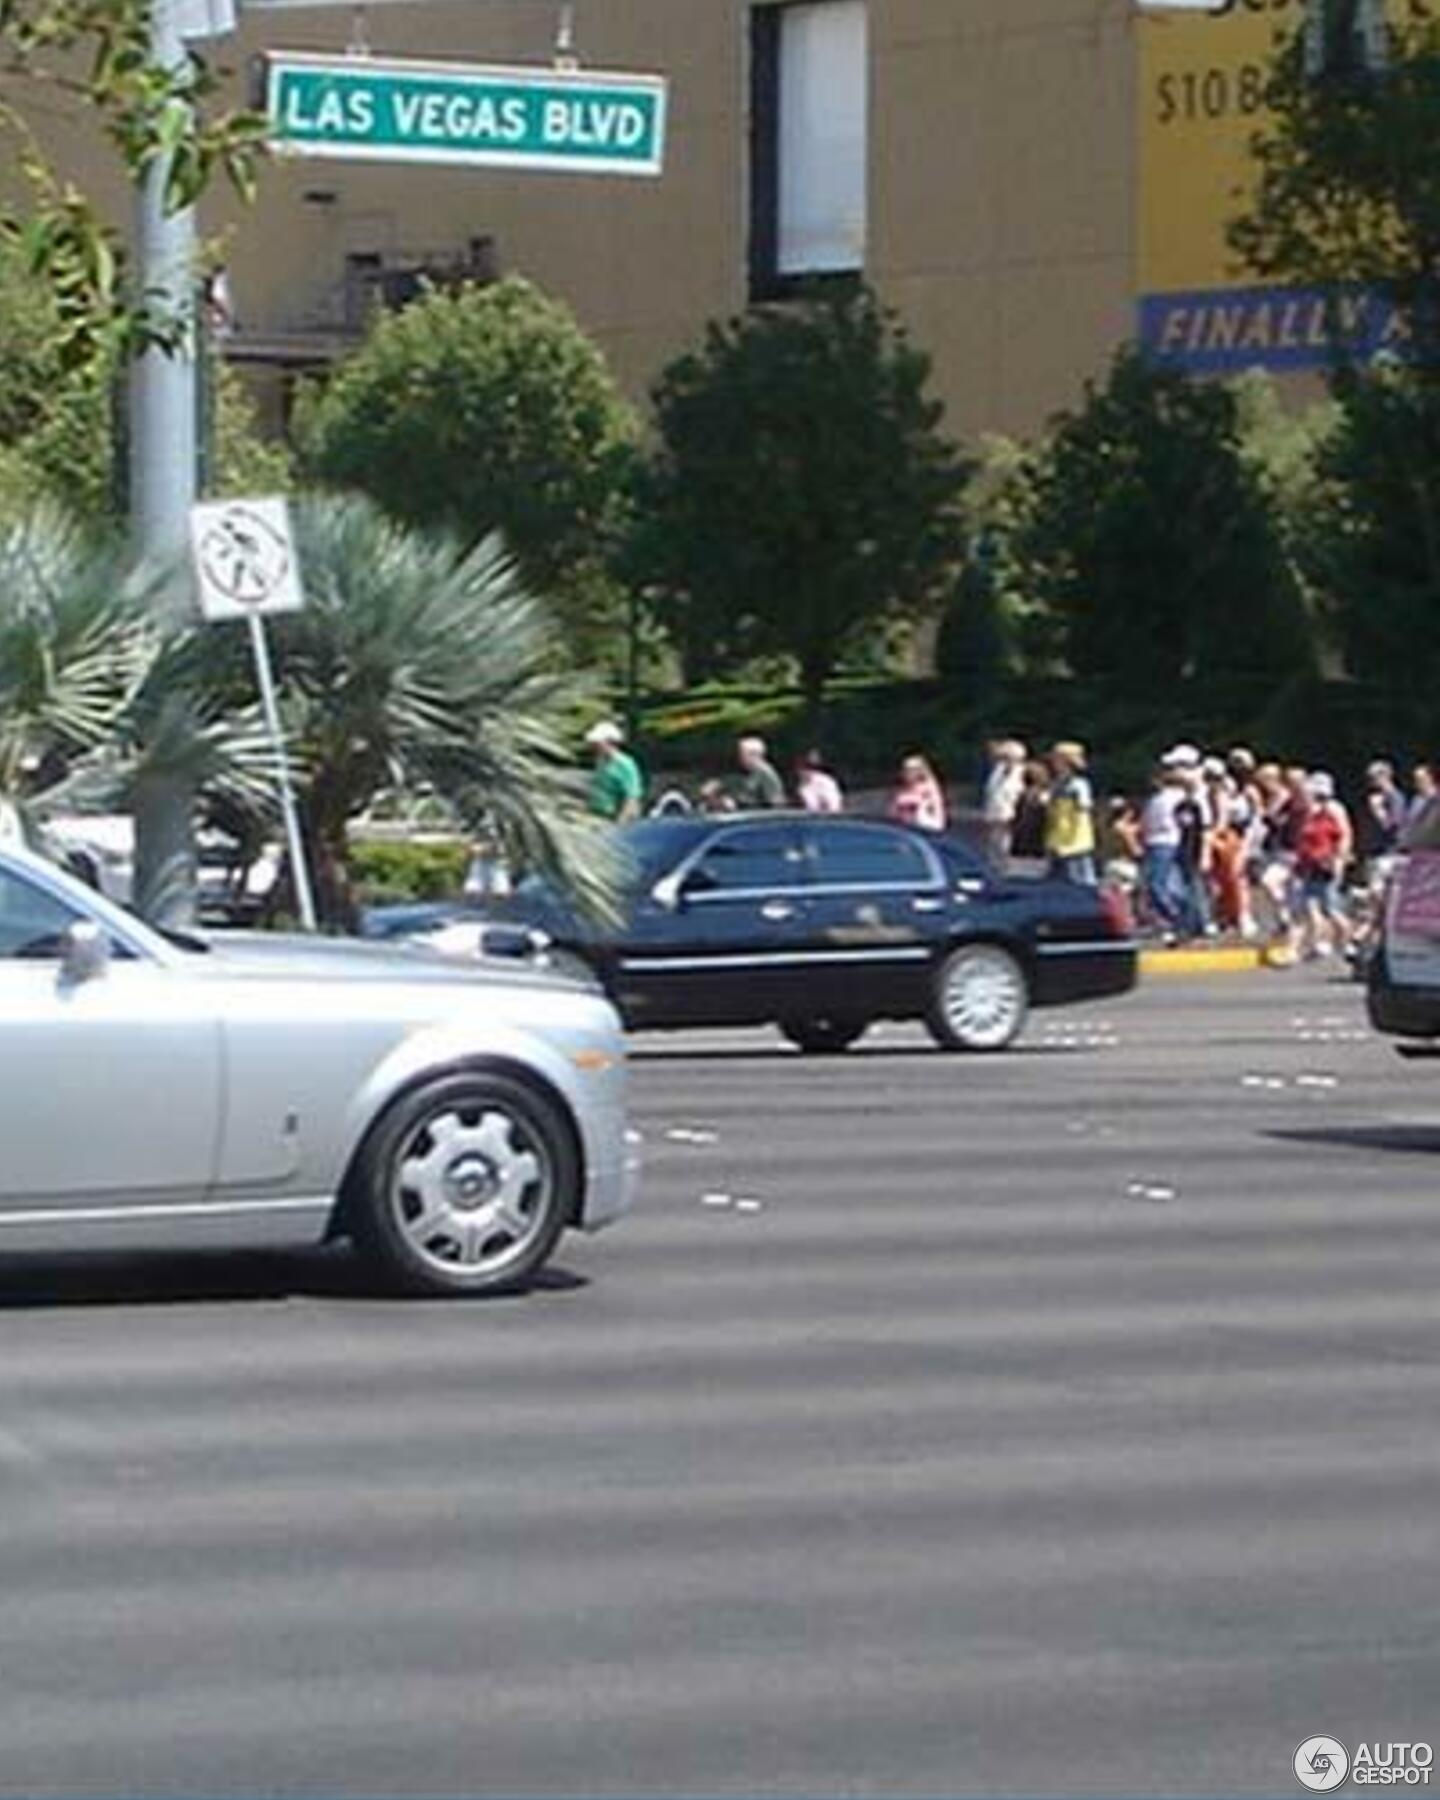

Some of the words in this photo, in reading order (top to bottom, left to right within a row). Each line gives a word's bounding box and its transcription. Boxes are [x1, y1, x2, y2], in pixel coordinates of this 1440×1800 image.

[287, 86, 373, 133] LAS
[393, 93, 527, 141] VEGAS
[544, 101, 645, 146] BLVD
